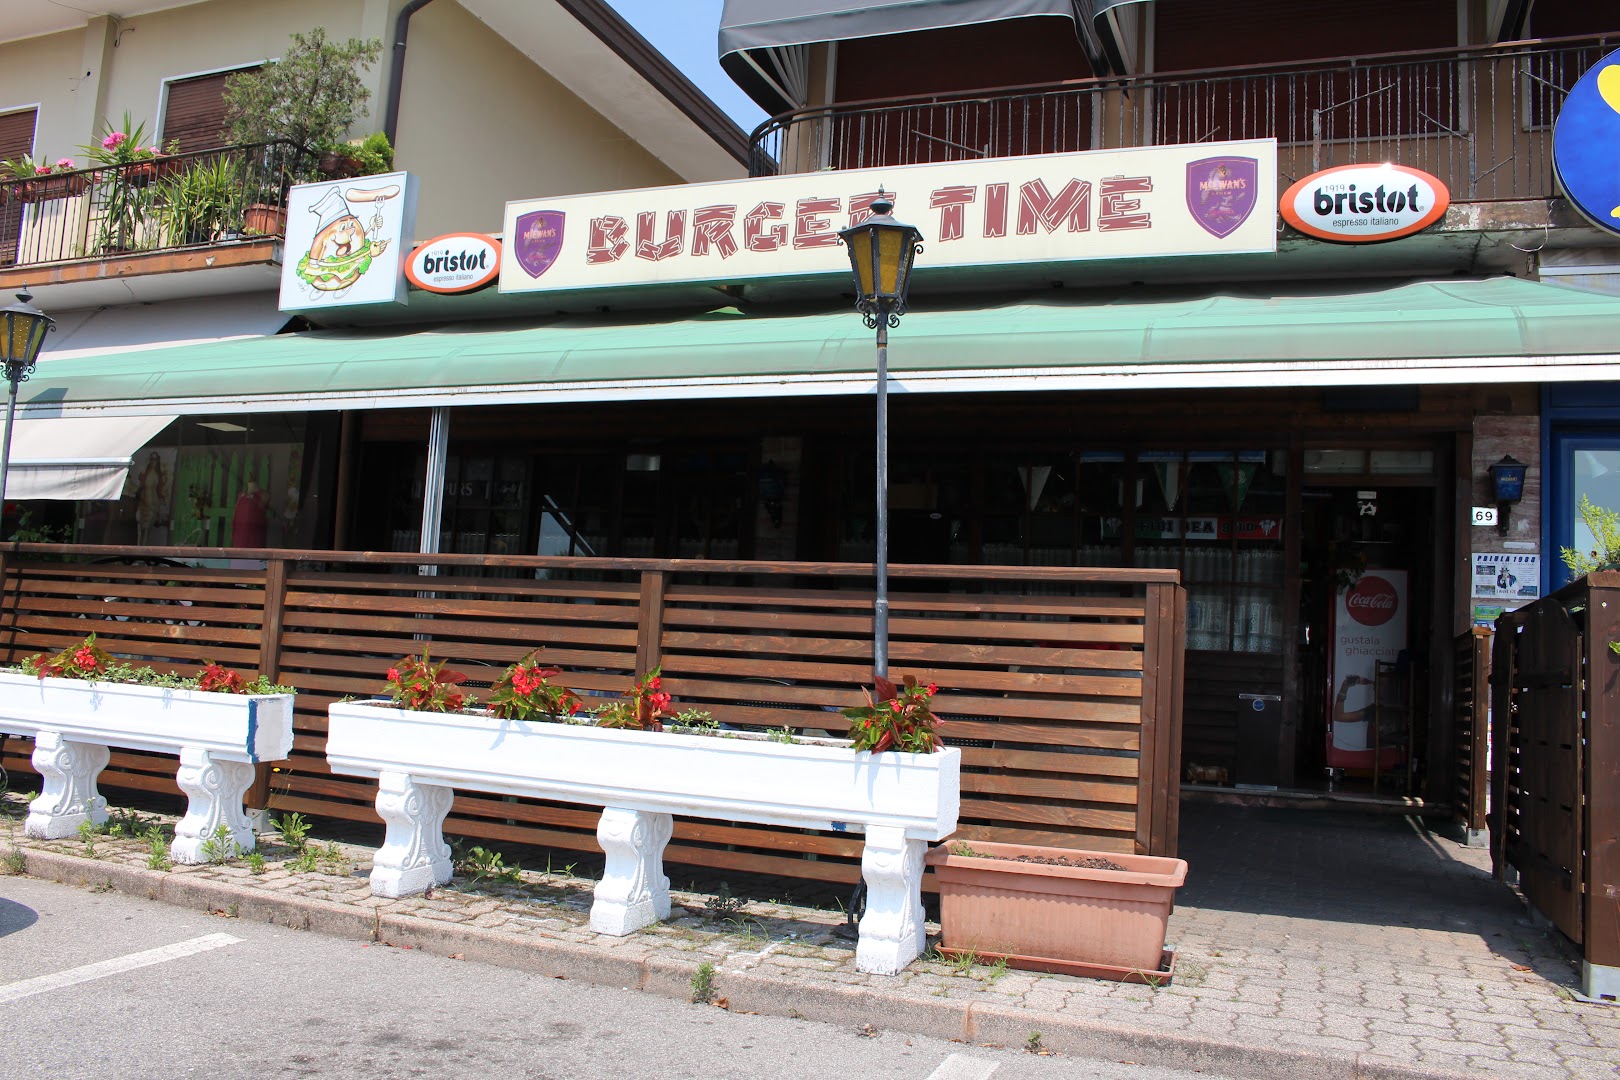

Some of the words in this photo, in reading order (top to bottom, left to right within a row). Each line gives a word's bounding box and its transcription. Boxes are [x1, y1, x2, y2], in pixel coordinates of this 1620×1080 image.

[1324, 184, 1346, 193] 1919
[1313, 183, 1420, 216] bristot
[929, 175, 1154, 243] TIME
[1332, 218, 1369, 229] espresso
[1369, 216, 1400, 226] italiano
[423, 248, 487, 275] bristot
[433, 274, 455, 283] espresso
[455, 273, 474, 281] italiano
[1475, 511, 1493, 521] 69
[1340, 635, 1380, 646] gustala
